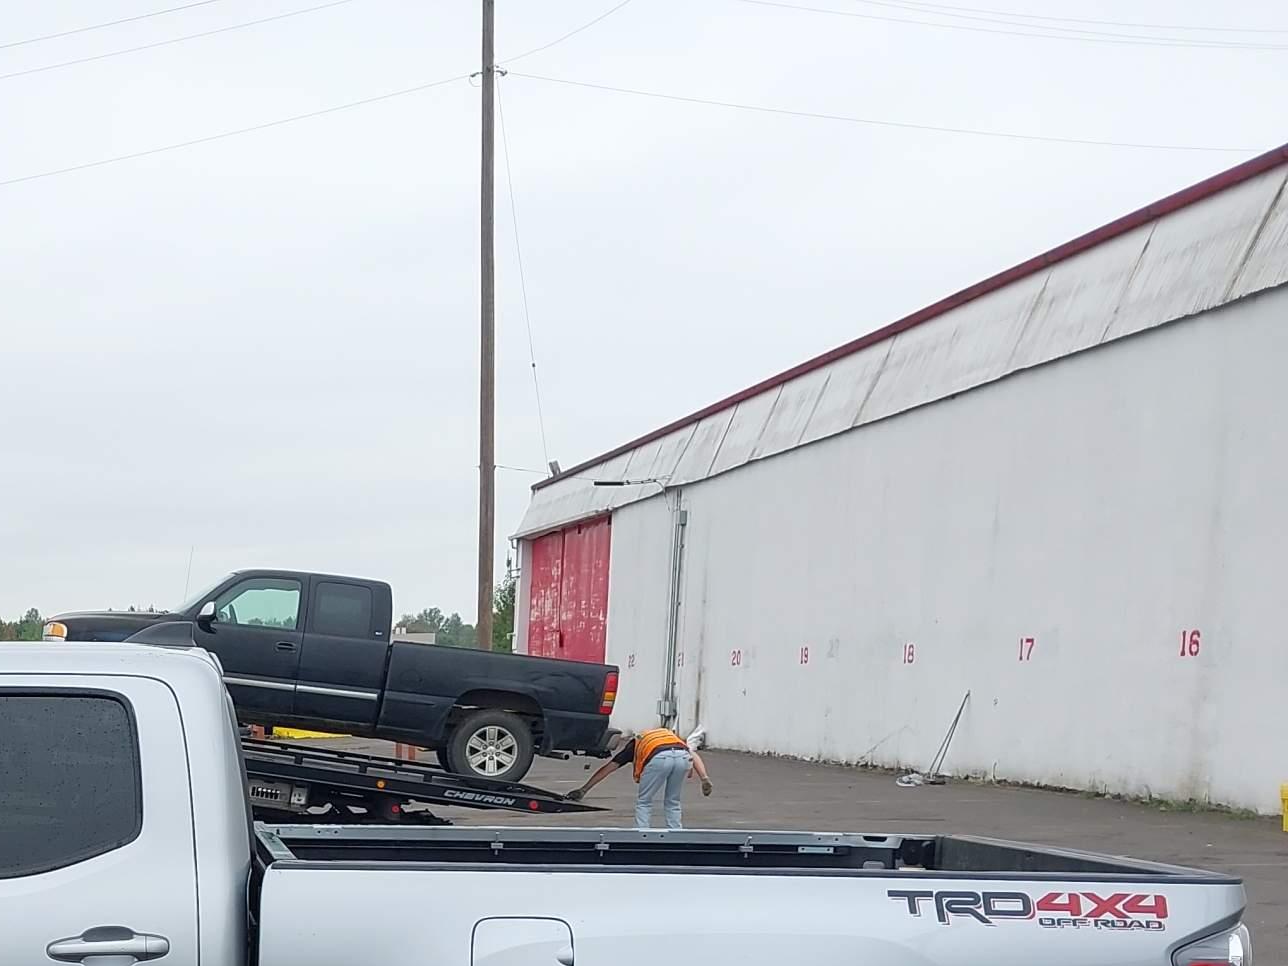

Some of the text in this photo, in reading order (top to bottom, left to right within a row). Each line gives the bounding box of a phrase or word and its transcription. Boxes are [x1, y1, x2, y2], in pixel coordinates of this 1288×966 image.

[1018, 638, 1035, 661] 17
[1179, 630, 1201, 657] 16
[628, 654, 636, 668] 22
[677, 652, 685, 667] 21
[731, 650, 742, 666] 20
[800, 647, 809, 664] 19
[903, 643, 915, 664] 18
[443, 789, 516, 806] CHEVRON
[886, 889, 1035, 926] TRD
[1038, 917, 1166, 931] OFF ROAD
